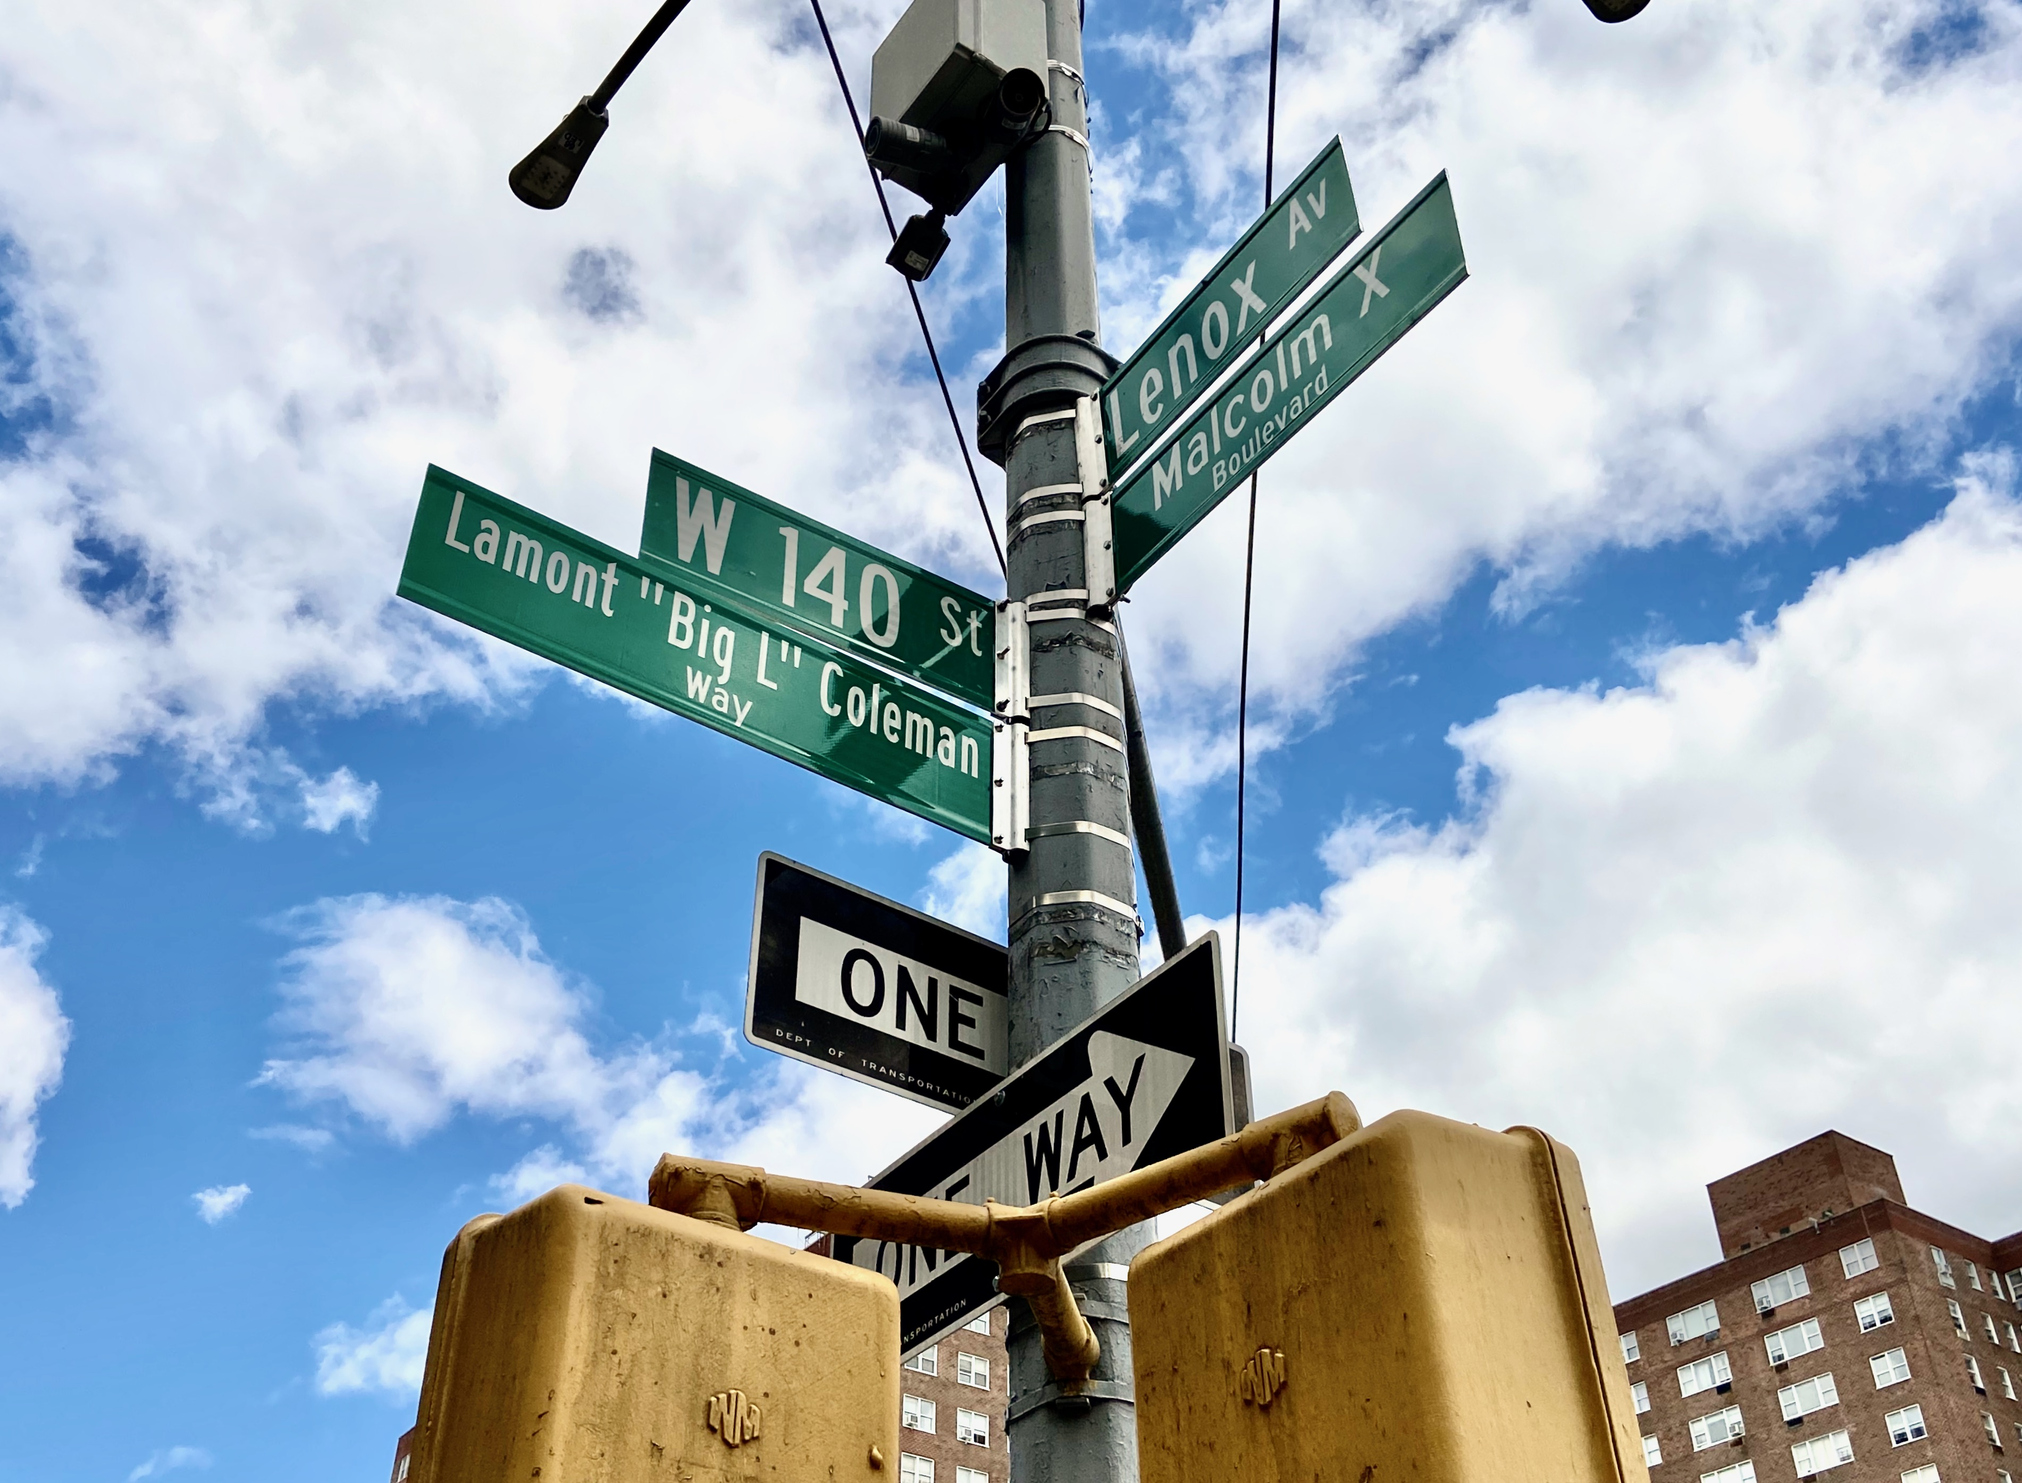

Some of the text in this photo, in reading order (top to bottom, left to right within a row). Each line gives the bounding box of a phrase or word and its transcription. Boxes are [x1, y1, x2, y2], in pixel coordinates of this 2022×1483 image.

[1109, 177, 1327, 458] Lenox Av
[1151, 245, 1390, 511] Malcolm X
[1212, 364, 1329, 492] Boulevard
[445, 491, 981, 779] Lamont "Big L" Coleman
[675, 475, 983, 657] W 140 St
[686, 665, 753, 727] Way
[775, 1028, 976, 1105] DEPT OF TRANSPORTATIO
[840, 947, 986, 1061] ONE
[1023, 1053, 1146, 1206] WAY
[901, 1298, 967, 1346] NSPORTATION
